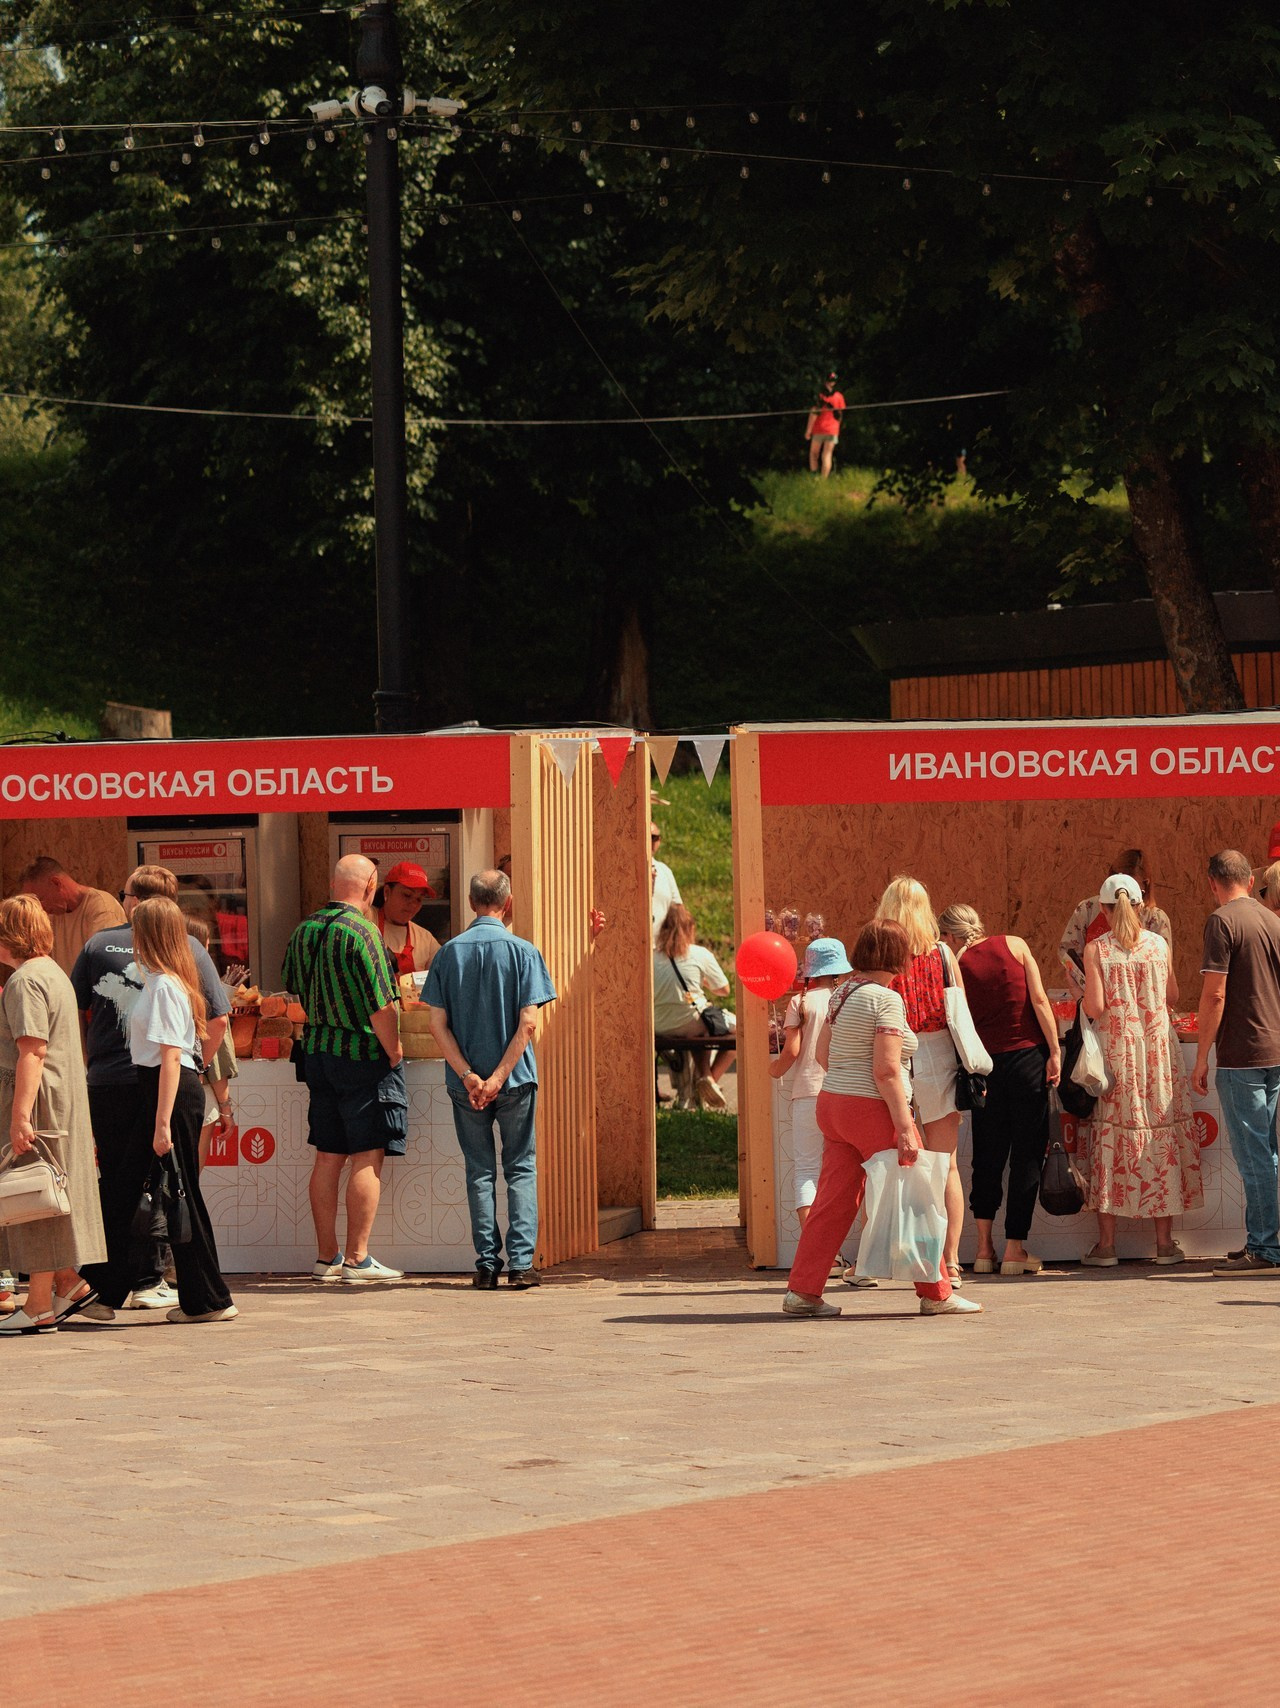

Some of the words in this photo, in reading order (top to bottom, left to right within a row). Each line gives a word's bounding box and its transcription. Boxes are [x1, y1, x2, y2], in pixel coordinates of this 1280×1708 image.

[889, 748, 1138, 781] ИВАНОВСКАЯ
[227, 766, 394, 795] ОБЛАСТЬ
[162, 847, 184, 857] ВКУСЫ
[185, 846, 211, 856] РОССИИ
[362, 841, 386, 850] ВКУСЫ
[387, 841, 413, 850] РОССИИ
